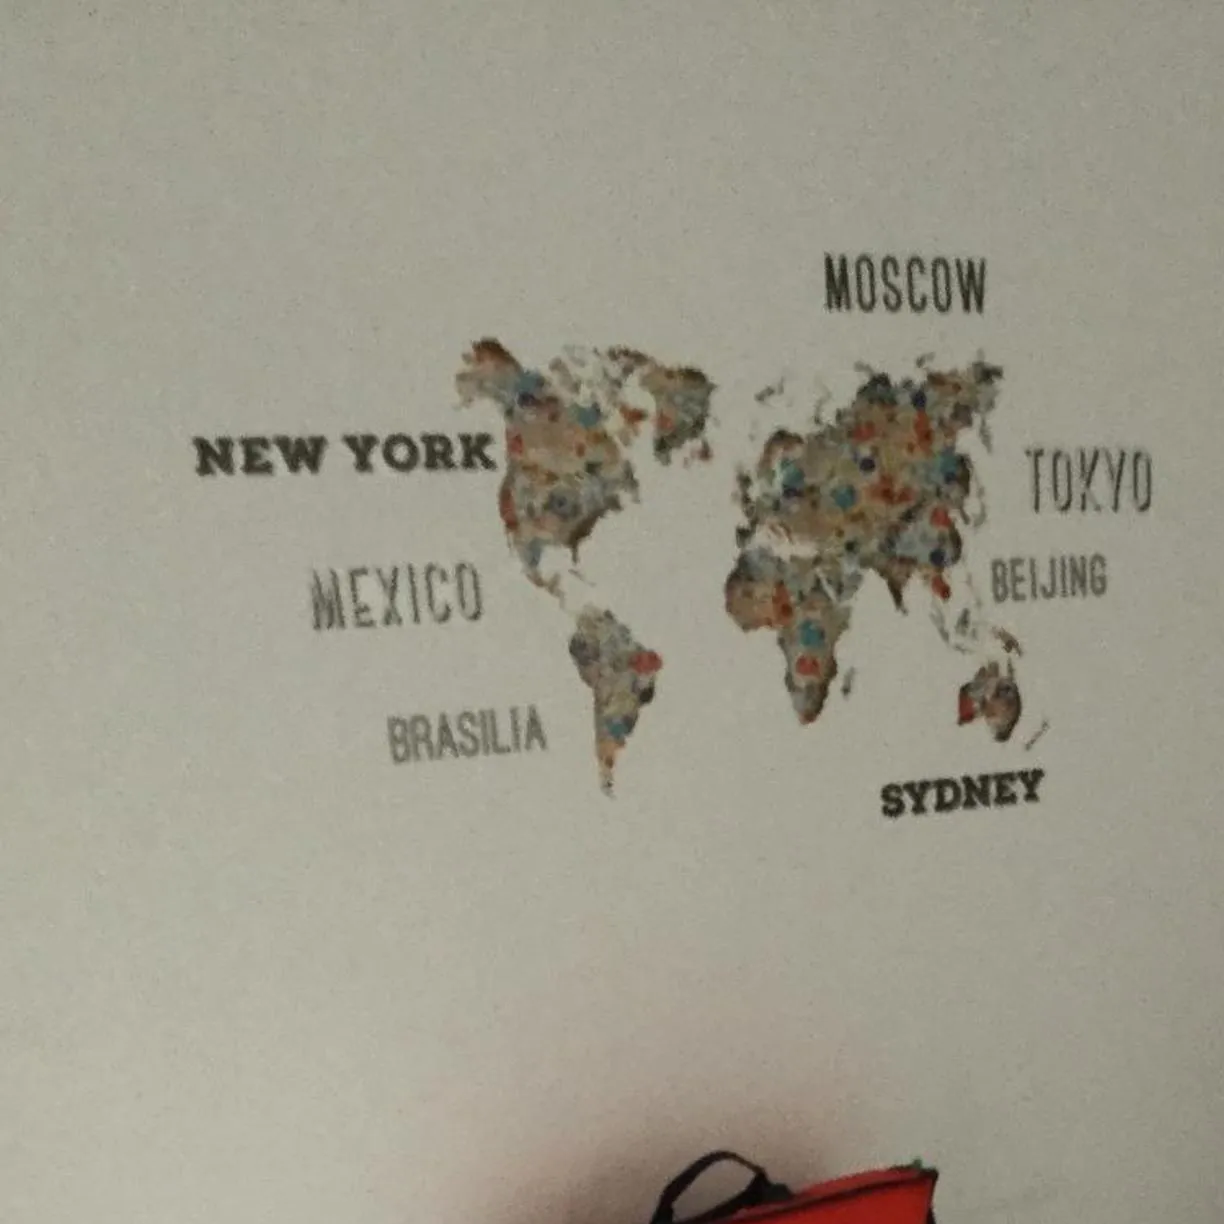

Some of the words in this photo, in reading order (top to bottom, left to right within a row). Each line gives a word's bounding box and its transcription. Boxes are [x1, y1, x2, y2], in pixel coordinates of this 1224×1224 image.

[822, 252, 988, 315] MOSCOW
[191, 434, 329, 478] NEW
[341, 431, 497, 474] YORK
[1024, 446, 1153, 514] TOKYO
[309, 561, 485, 633] MEXICO
[990, 552, 1109, 605] BEIJING
[386, 703, 549, 766] BRASILIA
[880, 767, 1046, 819] SYDNEY
